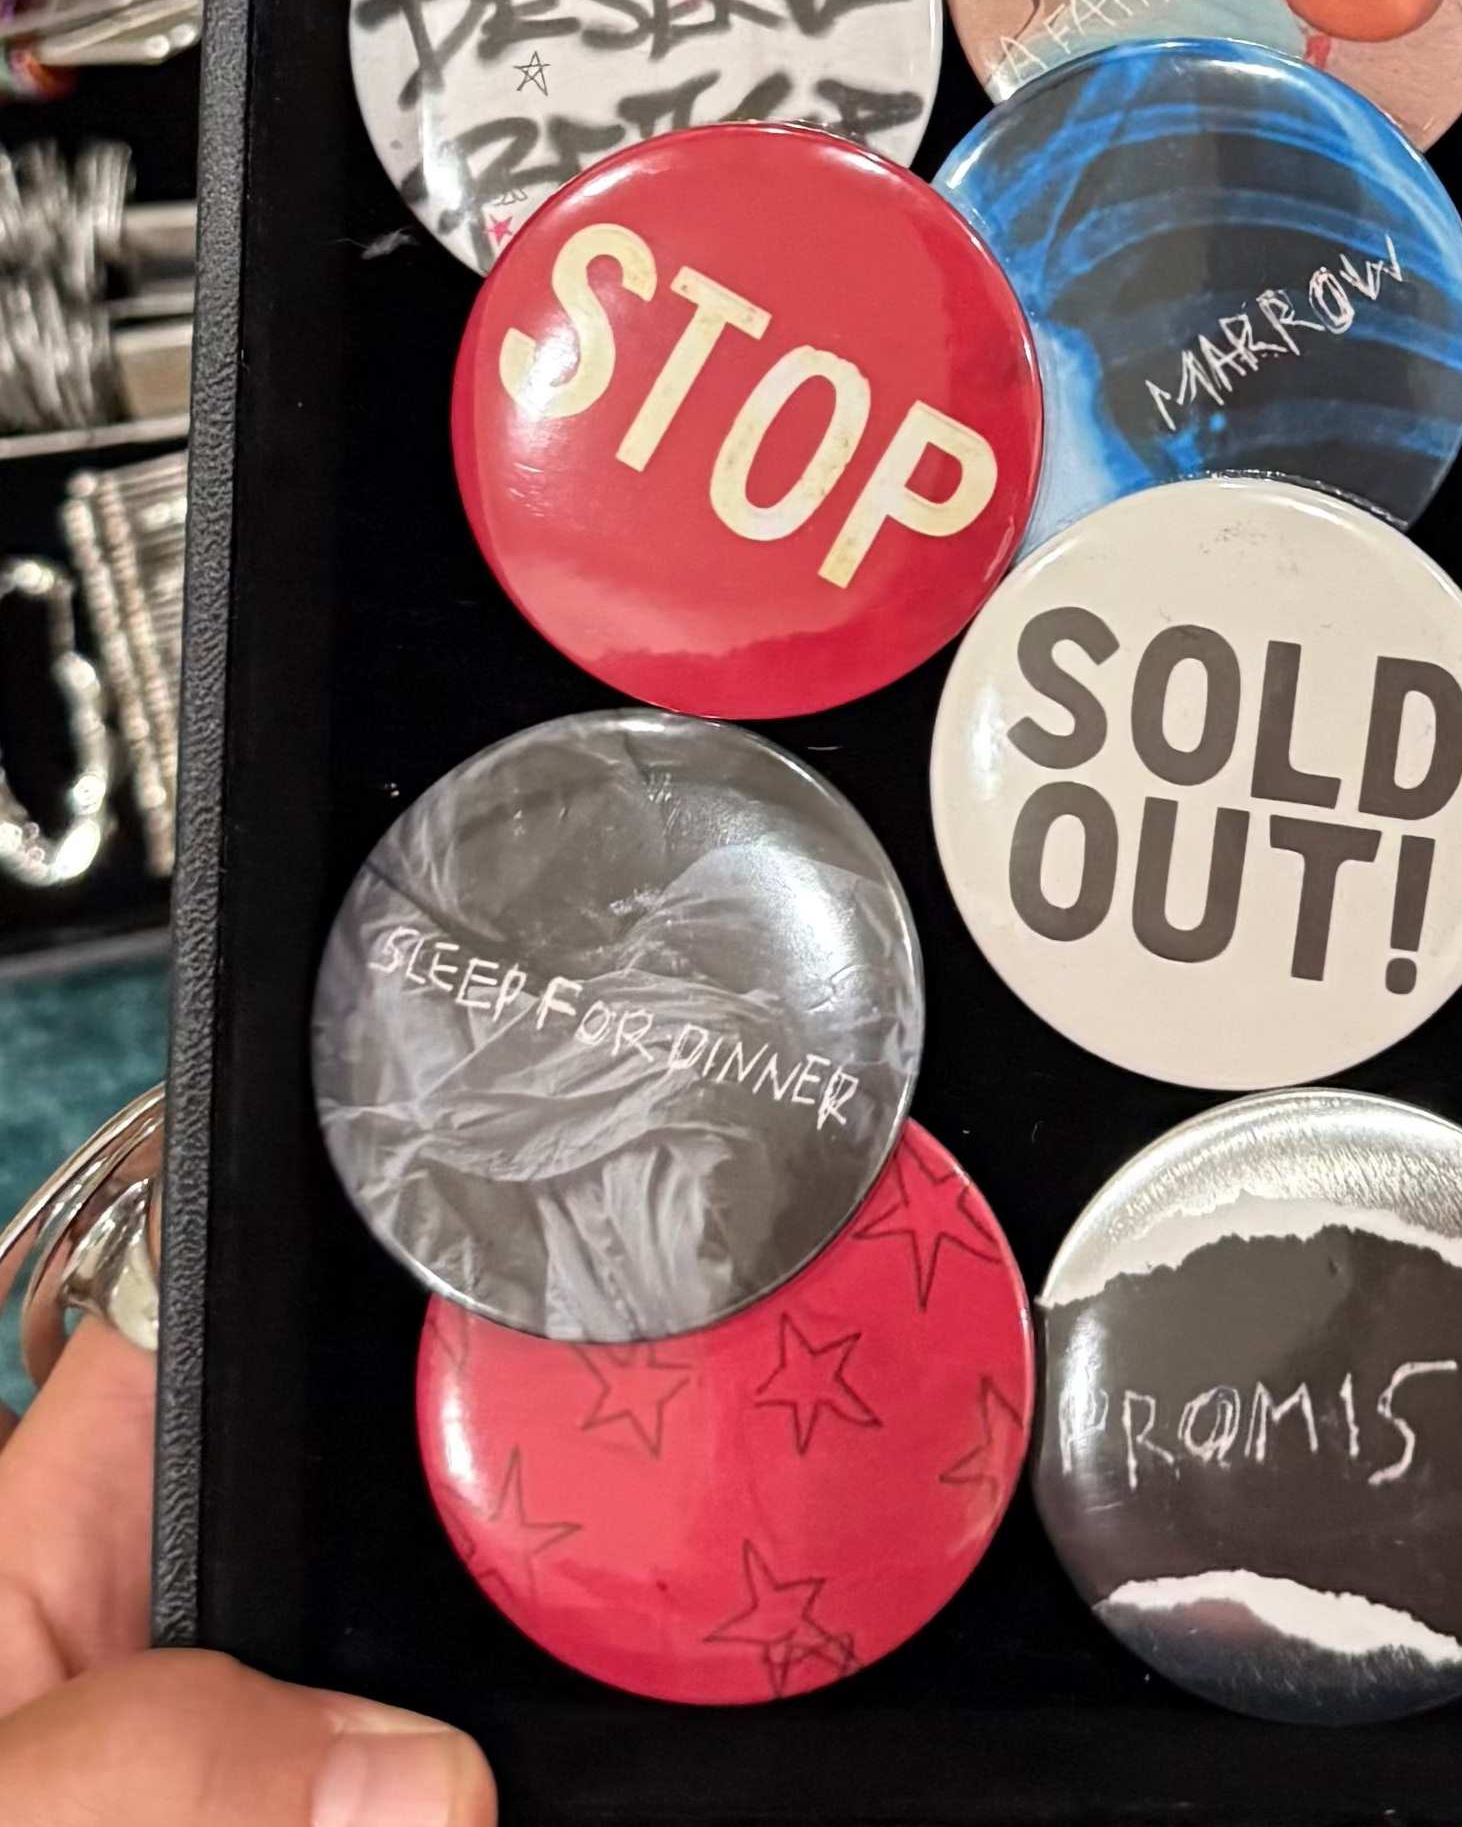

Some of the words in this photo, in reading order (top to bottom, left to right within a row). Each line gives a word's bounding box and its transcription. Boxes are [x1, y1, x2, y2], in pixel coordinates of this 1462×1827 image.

[999, 34, 1050, 81] A
[499, 222, 998, 590] STOP
[1144, 232, 1404, 432] MARROW
[1009, 780, 1437, 995] OUT!
[368, 926, 528, 1023] SLEEP
[536, 975, 655, 1062] FOR
[668, 1022, 861, 1131] DINNER
